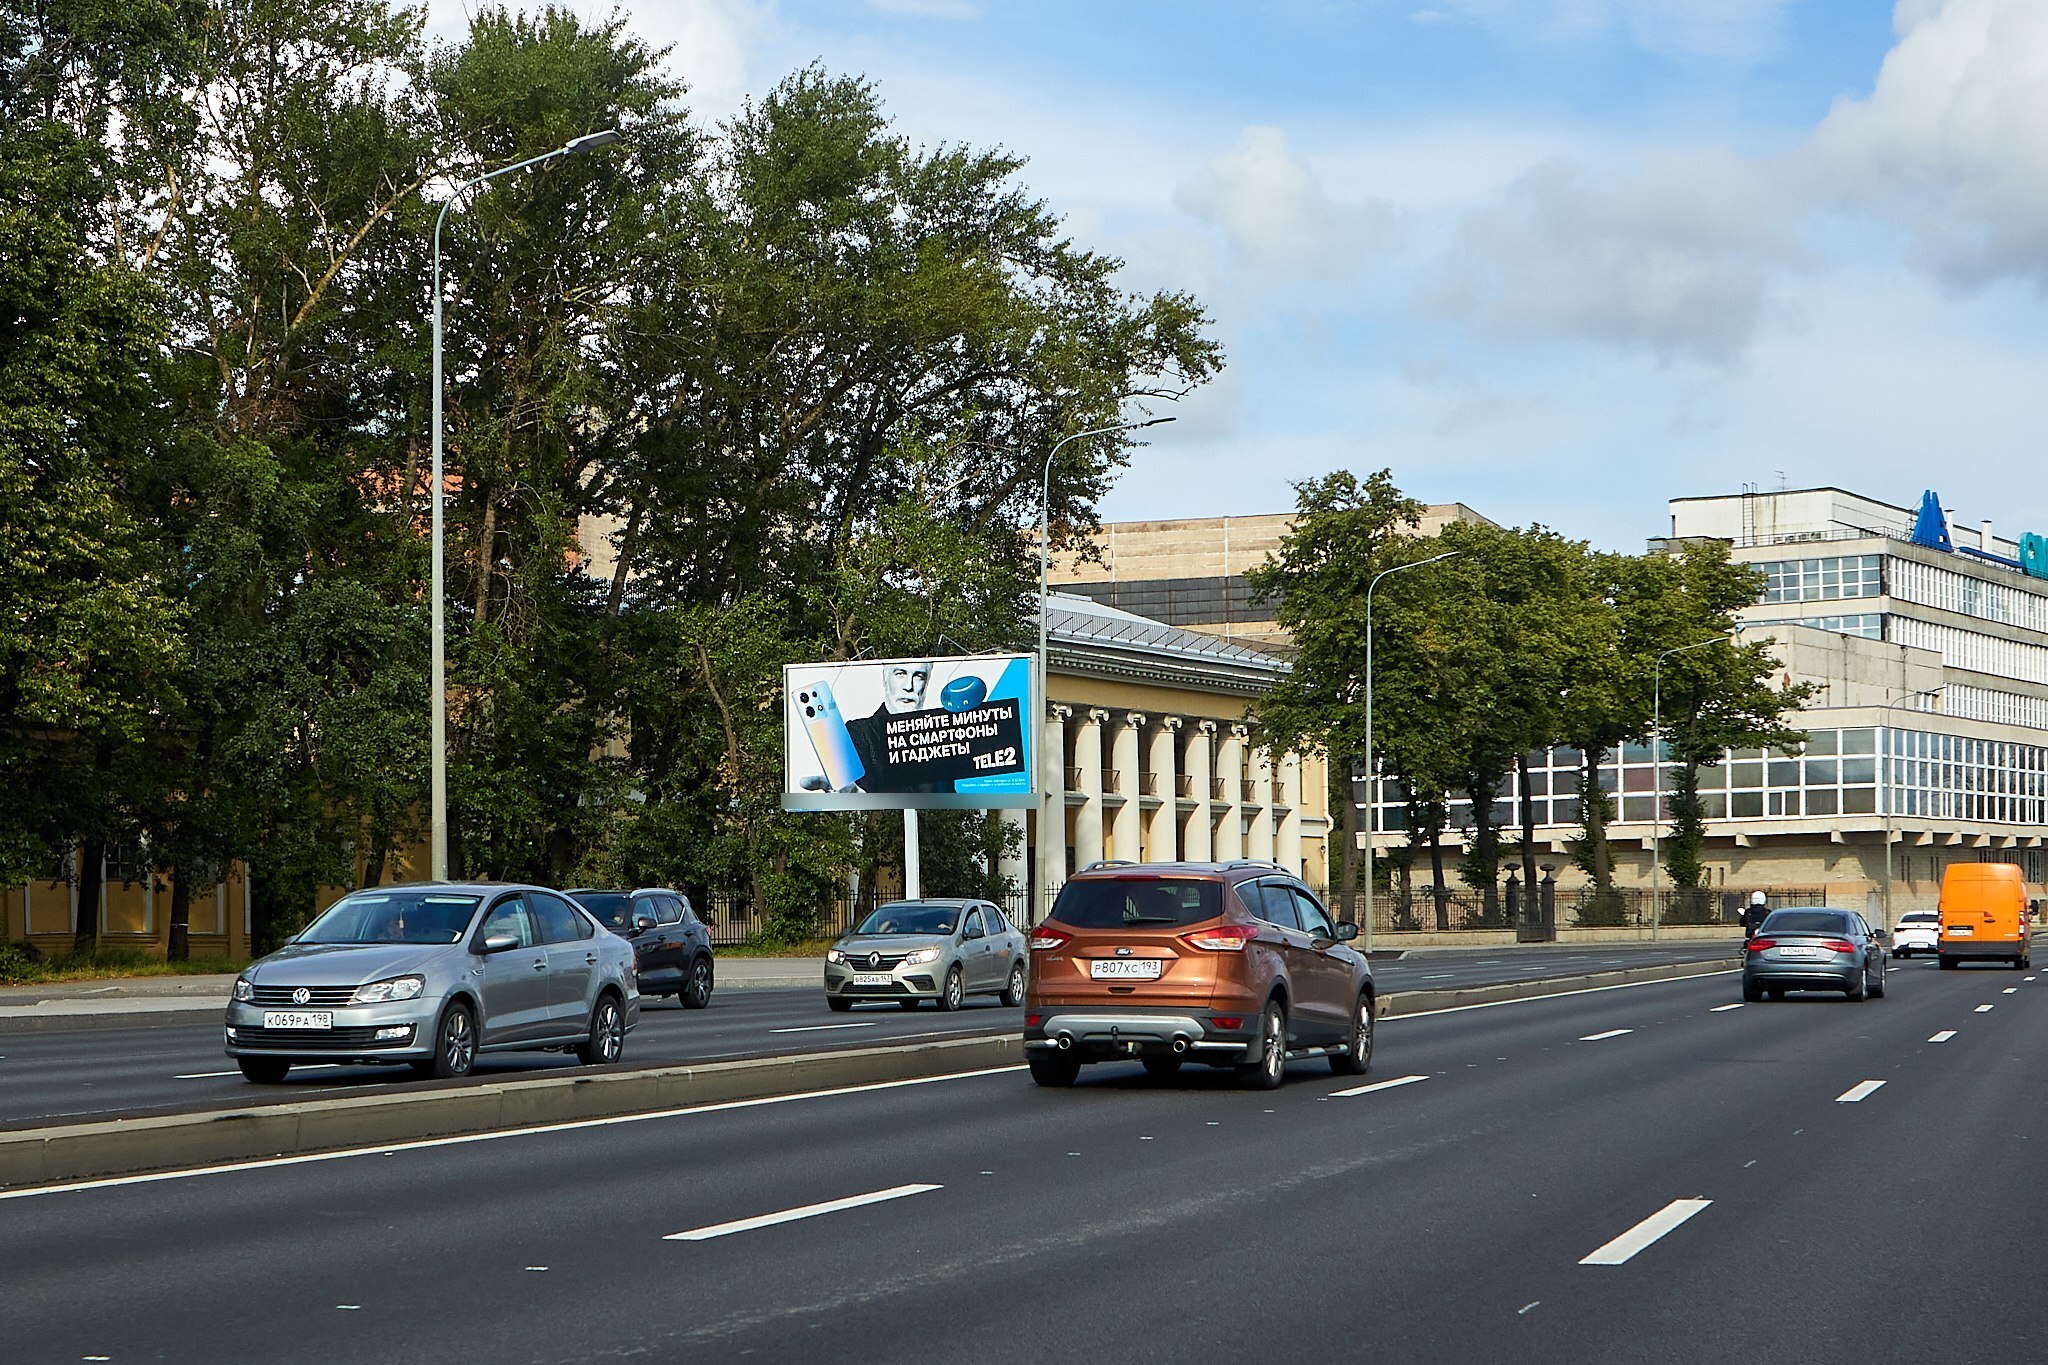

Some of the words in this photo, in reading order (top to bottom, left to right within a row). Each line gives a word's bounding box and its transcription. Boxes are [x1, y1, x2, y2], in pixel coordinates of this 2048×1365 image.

[886, 713, 950, 735] МЕНЯЙТЕ
[952, 706, 1013, 726] МИНУТЫ
[887, 735, 907, 749] НА
[909, 723, 998, 746] СМАРТФОНЫ
[888, 751, 899, 764] И
[901, 742, 970, 763] ГАДЖЕТЫ
[973, 747, 1017, 770] TELE2
